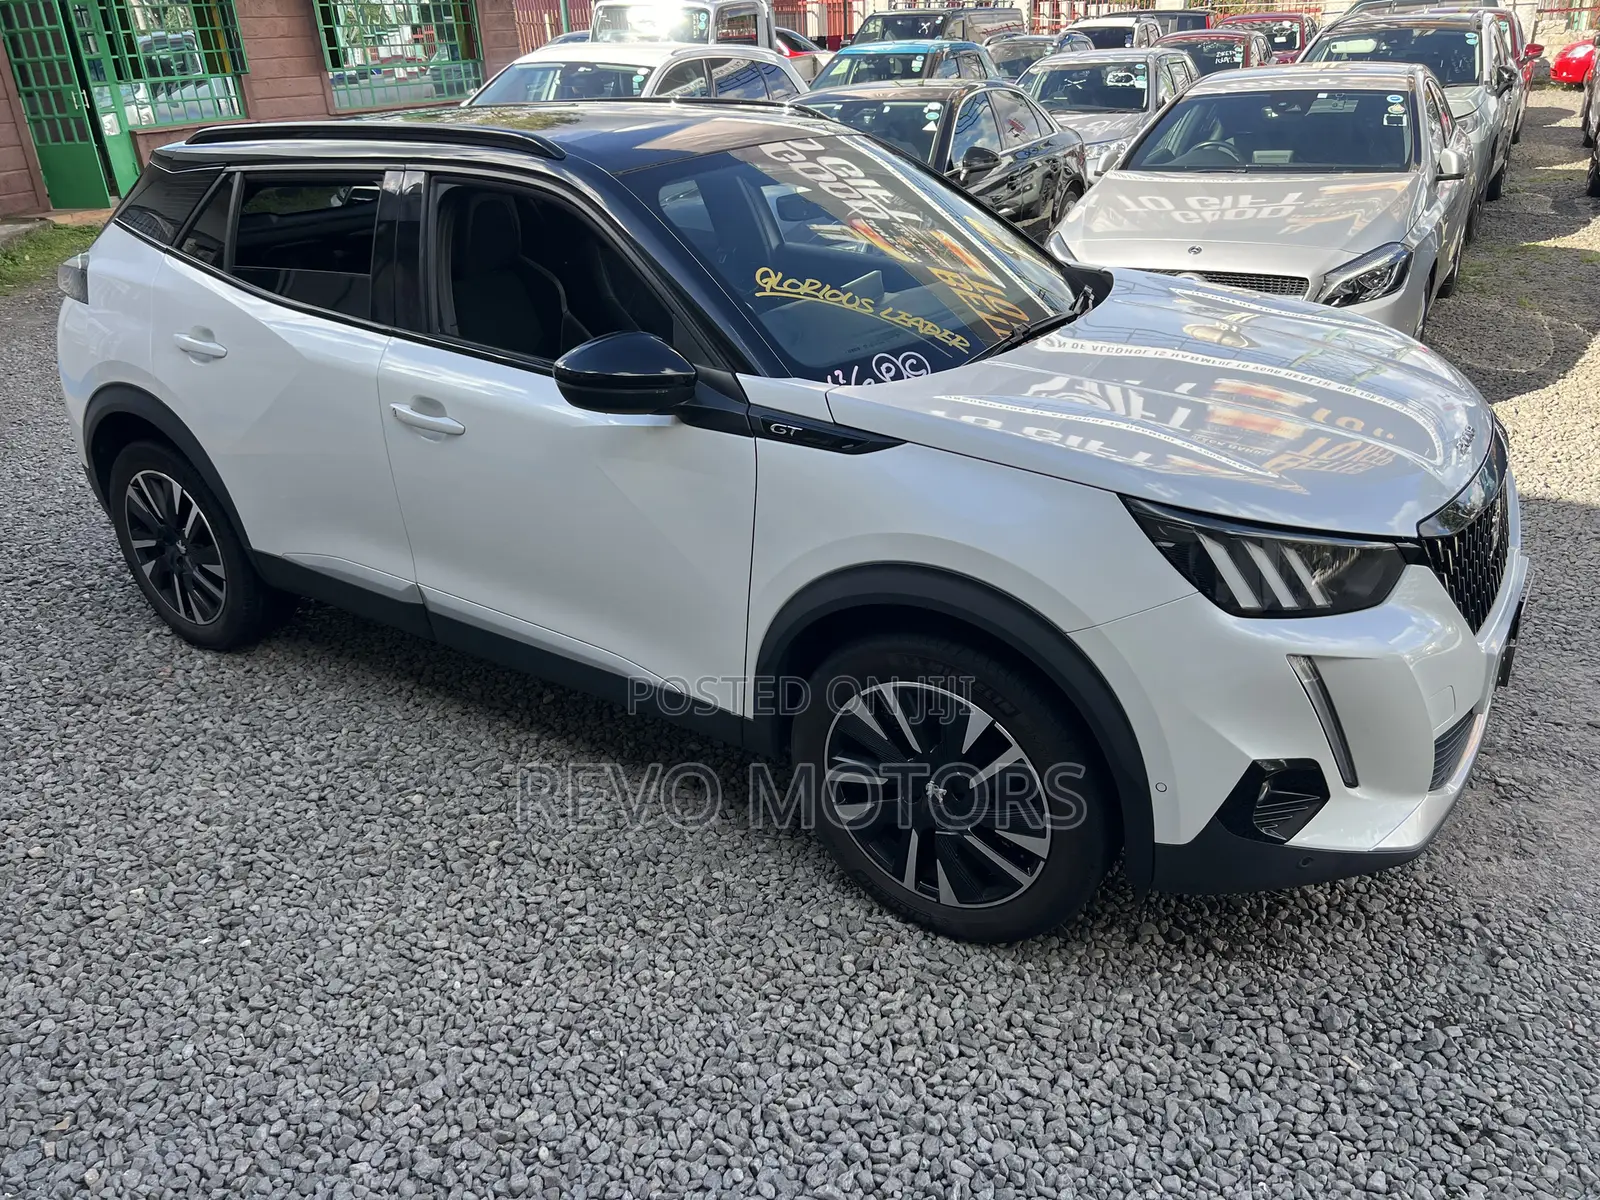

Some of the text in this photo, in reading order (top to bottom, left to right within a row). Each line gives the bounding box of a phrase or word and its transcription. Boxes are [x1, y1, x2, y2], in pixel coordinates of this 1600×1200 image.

[755, 266, 874, 313] GLORIOUS
[880, 307, 971, 354] LEADER
[769, 422, 803, 437] GT
